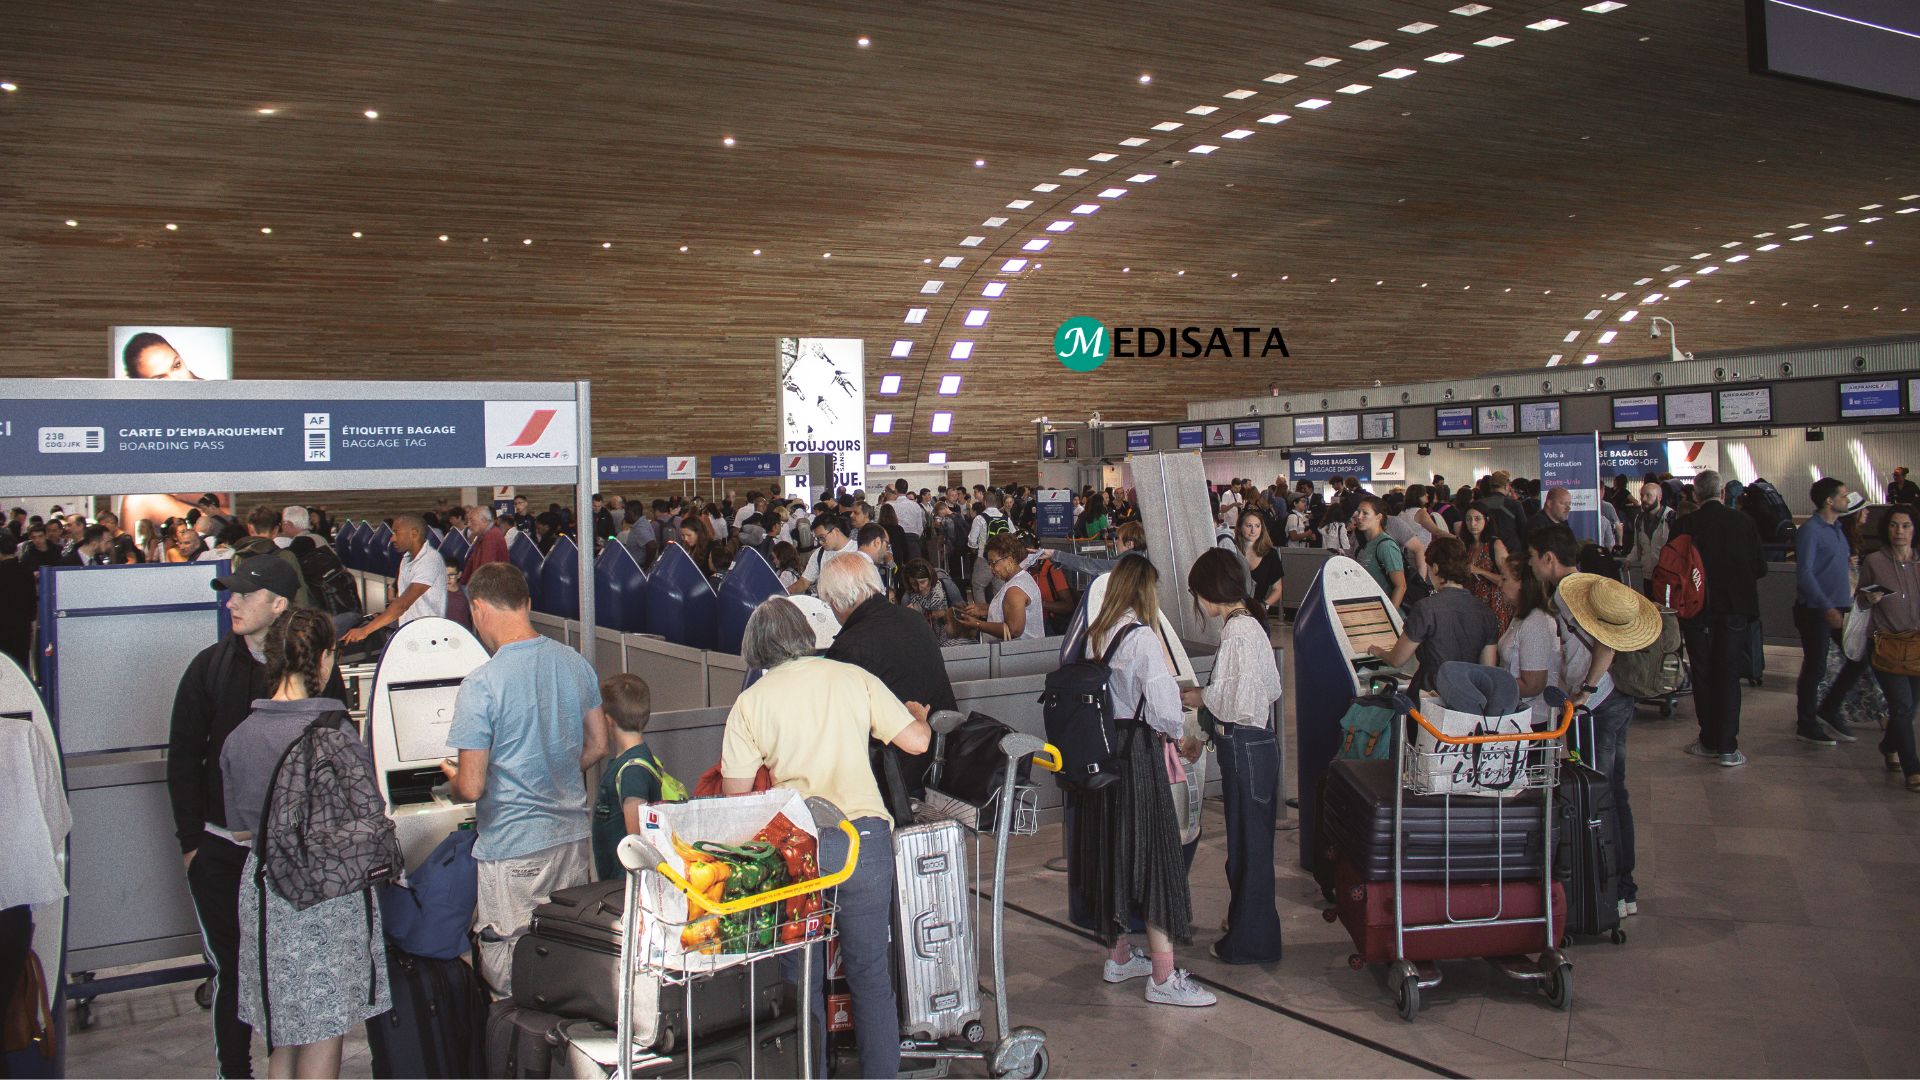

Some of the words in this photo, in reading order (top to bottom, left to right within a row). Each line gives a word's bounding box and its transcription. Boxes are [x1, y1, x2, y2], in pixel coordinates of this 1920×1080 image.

[309, 416, 325, 425] AF
[119, 428, 163, 437] CARTE
[166, 427, 285, 437] D'EMBARQUEMENT
[342, 425, 404, 435] ÉTIQUETTE
[407, 425, 456, 434] BAGAGE
[119, 441, 189, 451] BOARDING
[193, 440, 225, 450] PASS
[342, 439, 400, 448] BAGGAGE
[404, 438, 427, 447] TAG
[788, 440, 861, 451] TOUJOURS
[309, 450, 326, 459] JFK
[496, 452, 551, 460] AIRFRANCE
[1610, 449, 1649, 458] BAGAGES
[1619, 458, 1659, 466] DROP-OFF
